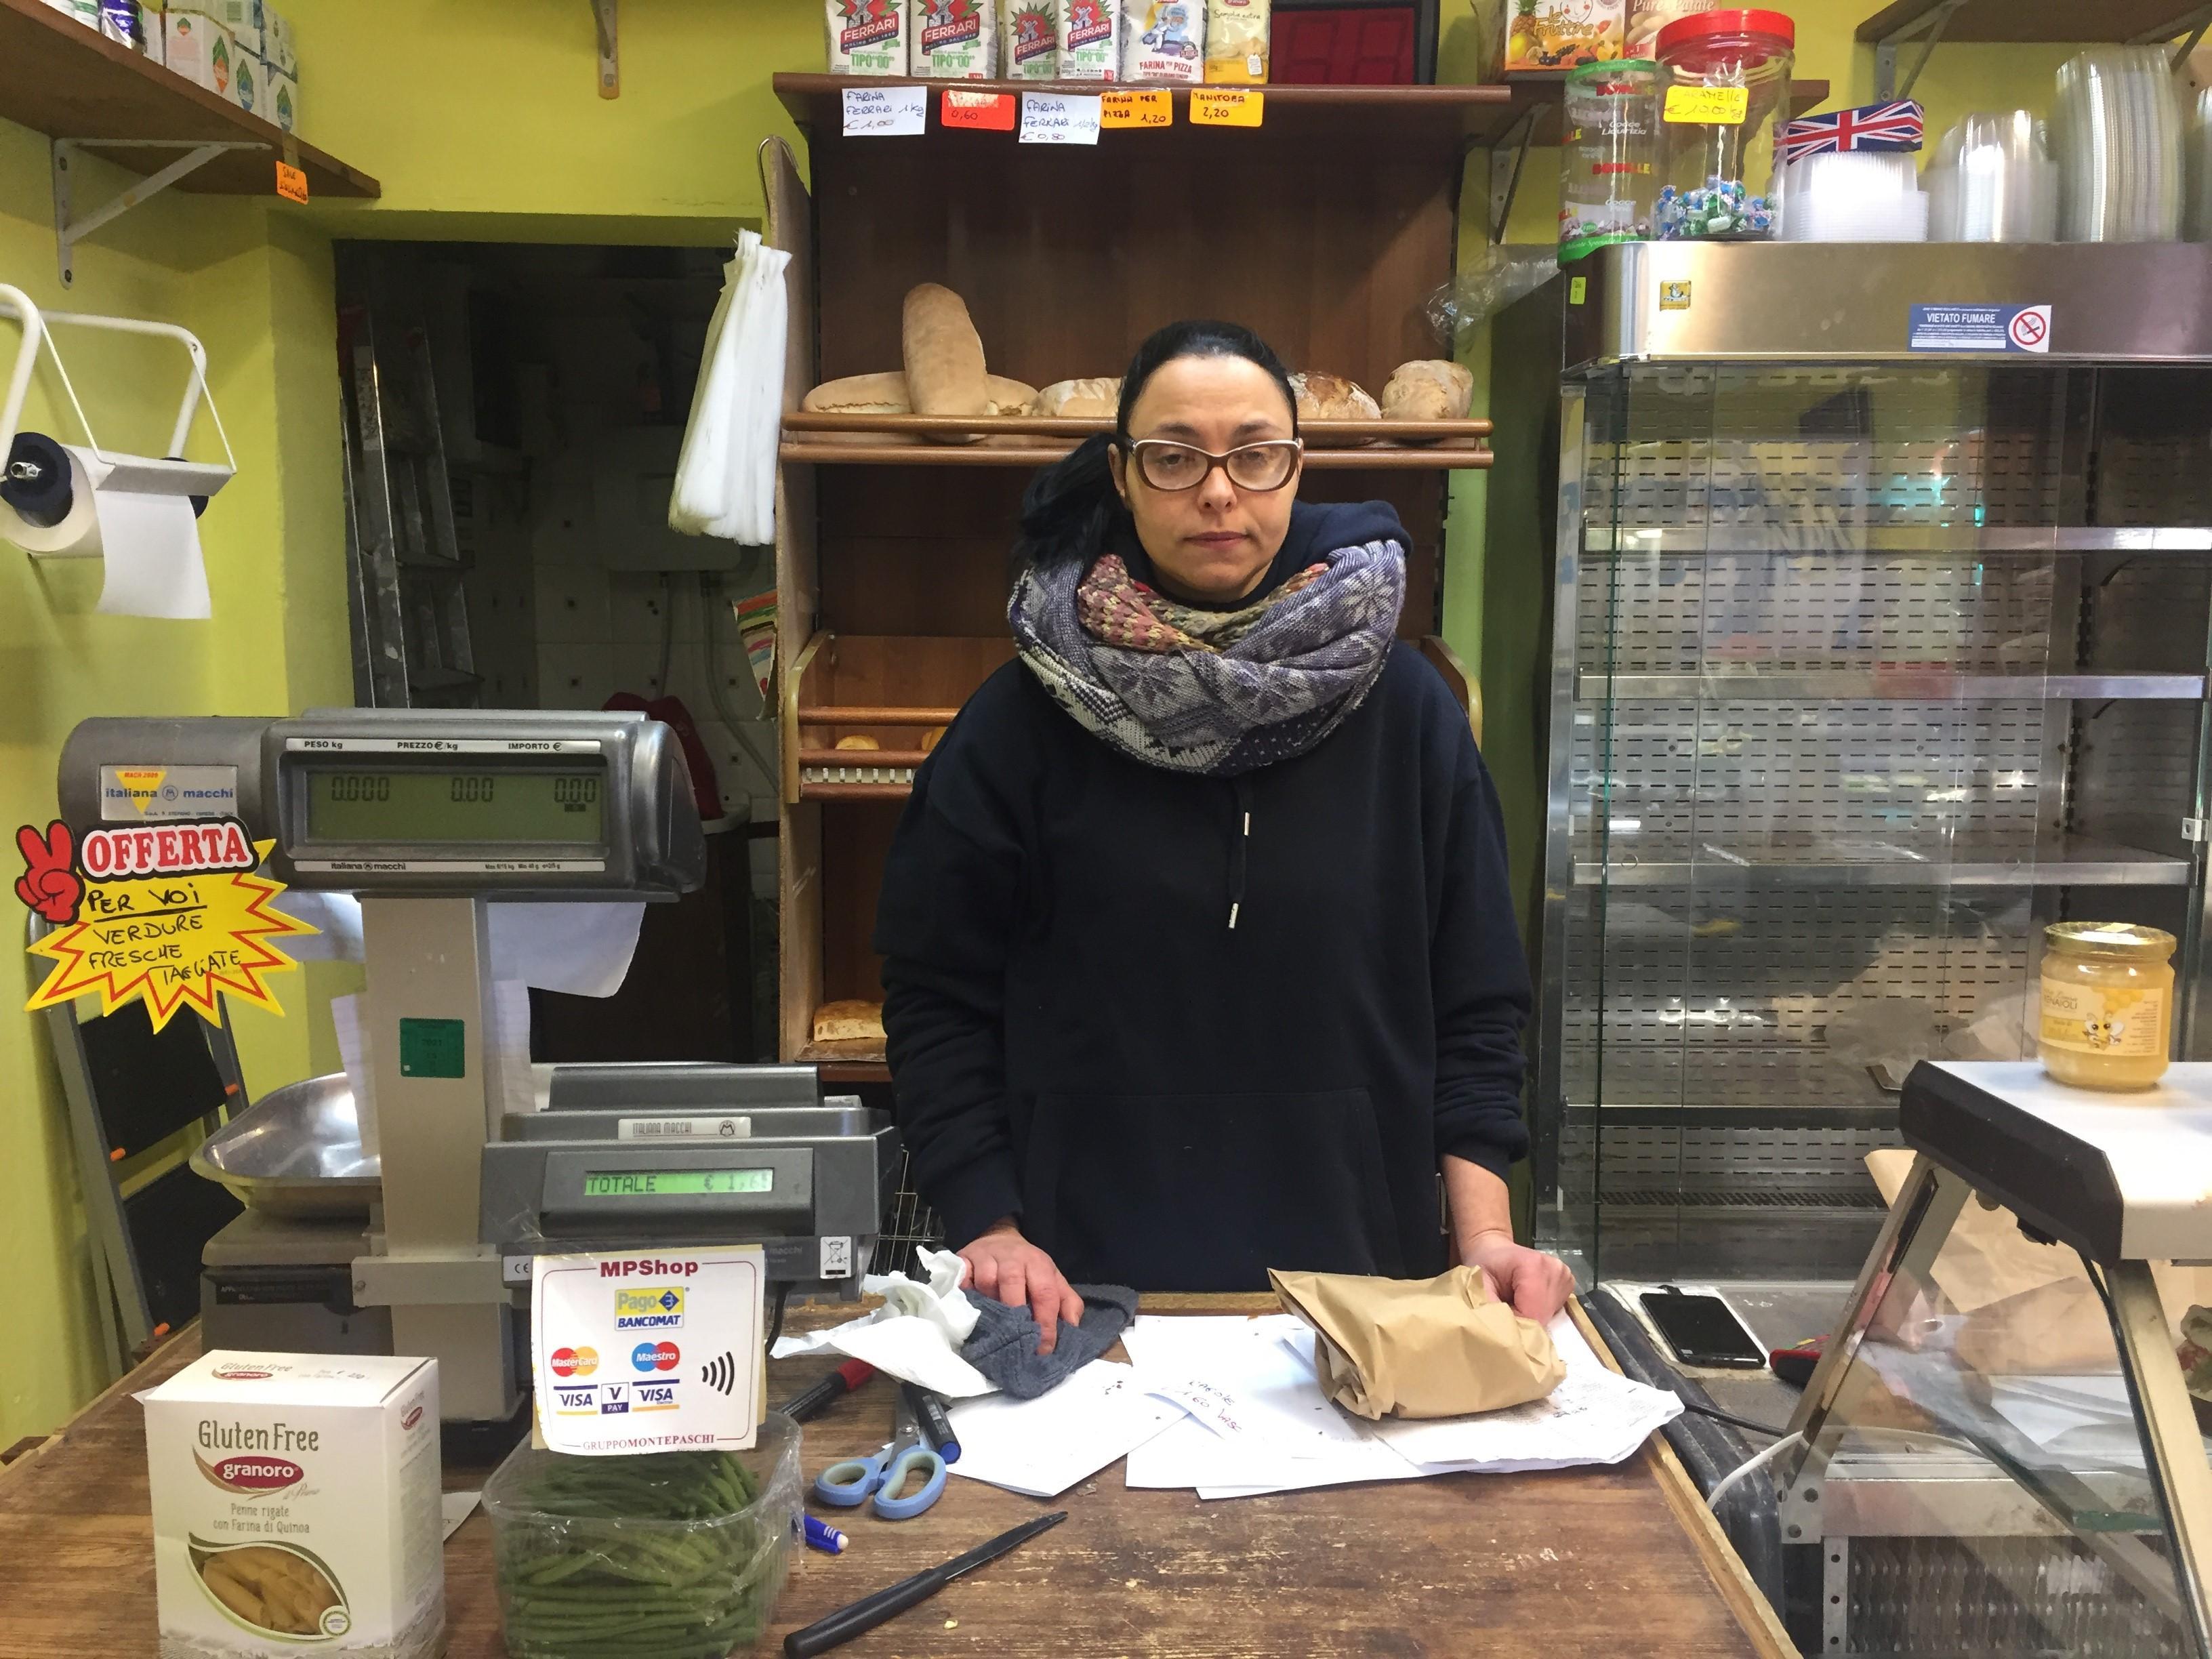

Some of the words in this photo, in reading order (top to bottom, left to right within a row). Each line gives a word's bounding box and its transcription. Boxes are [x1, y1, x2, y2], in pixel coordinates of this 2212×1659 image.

[844, 18, 895, 41] FERRARI
[925, 19, 976, 41] FERRARI
[1070, 22, 1109, 41] FERRARI
[1534, 16, 1593, 35] Fruttine
[1017, 36, 1055, 55] FERRARI
[851, 54, 872, 67] TIPO
[932, 54, 953, 67] TIPO
[1076, 52, 1092, 62] TIPO
[1023, 64, 1039, 74] TIPO
[1140, 60, 1165, 70] FARINA
[1174, 62, 1192, 74] PIZZA
[1101, 94, 1133, 103] FARINA
[1140, 94, 1158, 103] PER
[1193, 91, 1246, 103] MANITOBA
[951, 110, 978, 121] 0,60
[1141, 114, 1166, 124] 1,20
[1202, 106, 1229, 119] 2,20
[1927, 313, 1960, 323] VIETATO
[1961, 314, 1996, 323] FUMARE
[331, 741, 343, 750] kg
[397, 741, 434, 750] PREZZO
[106, 787, 157, 798] italiana
[183, 787, 233, 798] macchi
[331, 775, 390, 802] 0.000
[451, 777, 495, 803] 0.00
[553, 777, 597, 803] 0.00
[87, 827, 248, 873] OFFERTA
[87, 889, 135, 914] PER
[93, 915, 203, 945] VERDURE
[89, 944, 182, 970] FRESCHE
[633, 1122, 661, 1134] ITALIANA
[663, 1122, 692, 1134] MACCHI
[588, 1174, 657, 1193] TOTALE
[600, 1259, 698, 1277] MPShop
[618, 1292, 657, 1313] Pago
[617, 1315, 681, 1328] BANCOMAT
[551, 1357, 597, 1368] MasterCard
[636, 1352, 676, 1362] Maestro
[221, 1362, 264, 1371] Gluten
[559, 1393, 593, 1407] VISA
[608, 1387, 622, 1400] V
[637, 1388, 674, 1402] VISA
[199, 1420, 268, 1450] Gluten
[273, 1422, 319, 1452] Free
[583, 1434, 715, 1450] GRUPPOMONTEPASCHI
[223, 1463, 294, 1479] granoro
[231, 1502, 258, 1517] Penne
[262, 1506, 289, 1521] rigate
[213, 1519, 228, 1530] con
[232, 1519, 260, 1532] Farina
[264, 1520, 273, 1533] di
[276, 1521, 310, 1534] Quinoa
